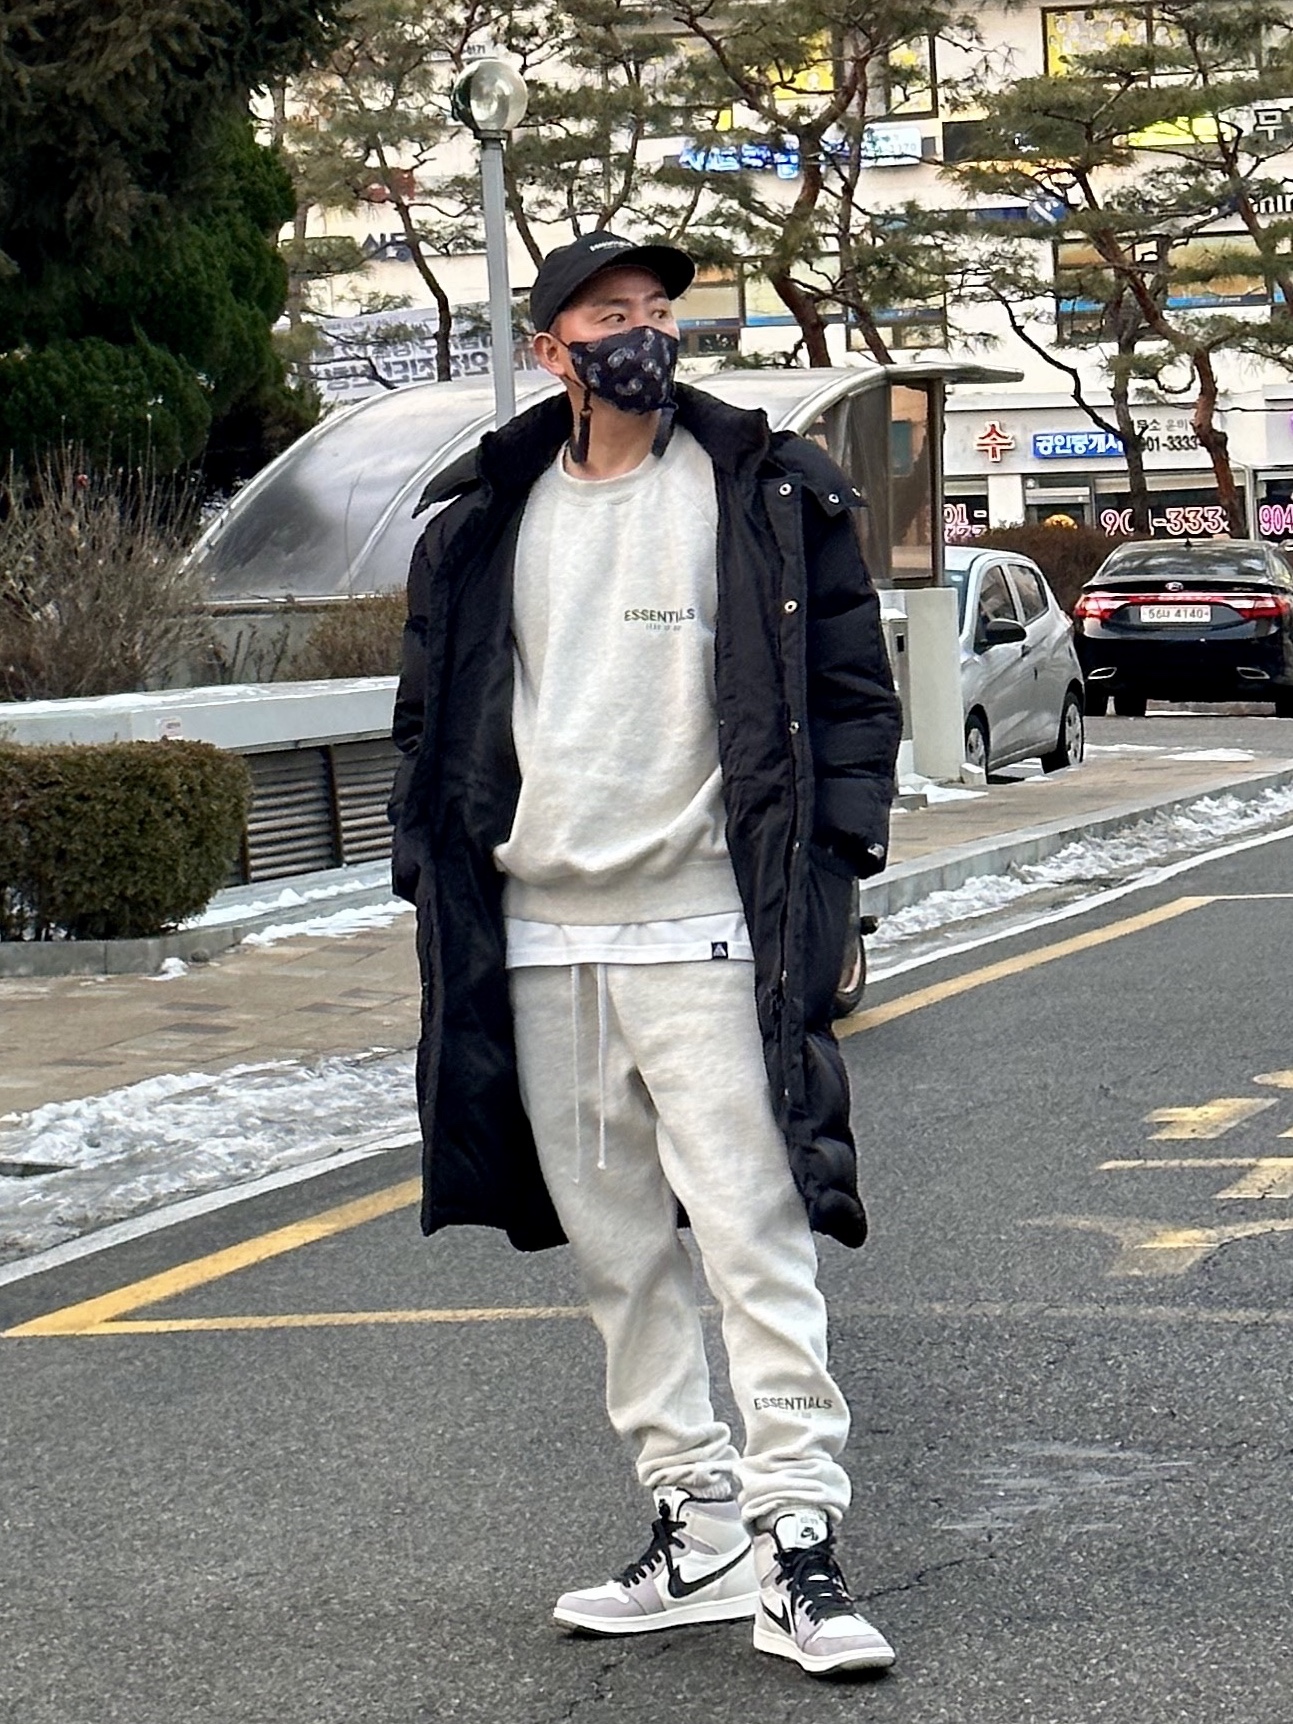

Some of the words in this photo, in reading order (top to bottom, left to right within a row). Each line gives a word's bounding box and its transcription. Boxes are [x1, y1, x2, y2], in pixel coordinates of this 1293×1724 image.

[974, 421, 1016, 462] 수
[1141, 435, 1198, 451] 01-3333
[753, 1396, 833, 1410] ESSENTIALS
